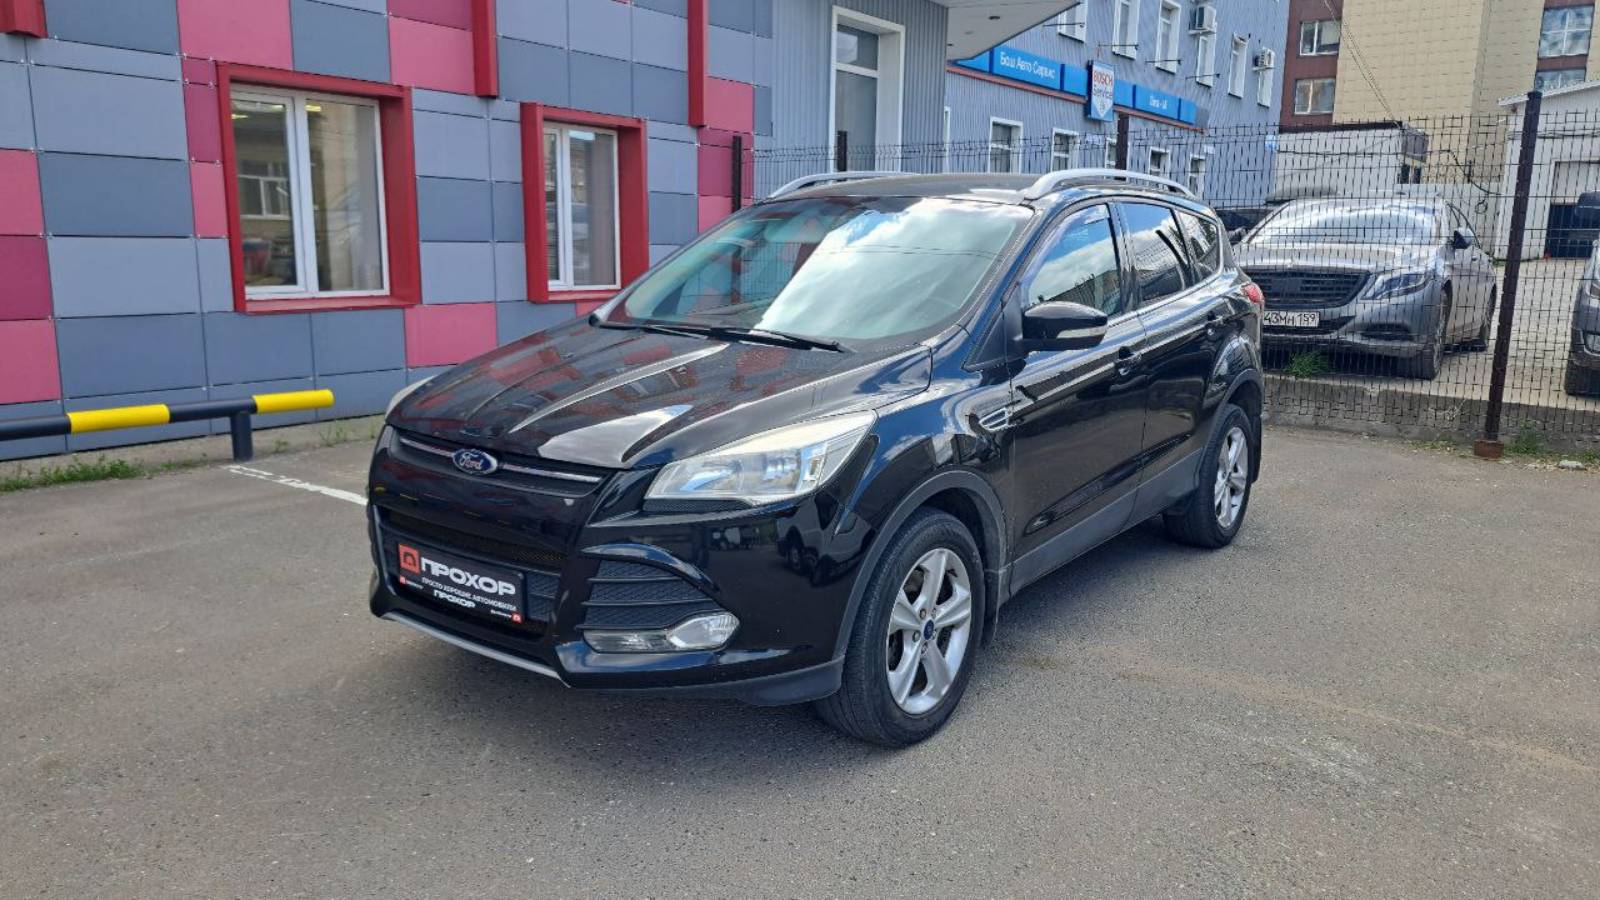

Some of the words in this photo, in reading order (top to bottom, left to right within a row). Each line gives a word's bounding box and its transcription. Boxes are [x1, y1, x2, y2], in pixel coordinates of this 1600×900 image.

[1016, 56, 1032, 73] Авто
[1093, 70, 1113, 86] BOSCH
[460, 451, 484, 470] Ford
[421, 557, 516, 596] ПРОХОР
[421, 577, 443, 590] ПРОСТО
[472, 594, 517, 612] АВТОМОБИЛИ
[433, 589, 476, 608] ПРОХОР
